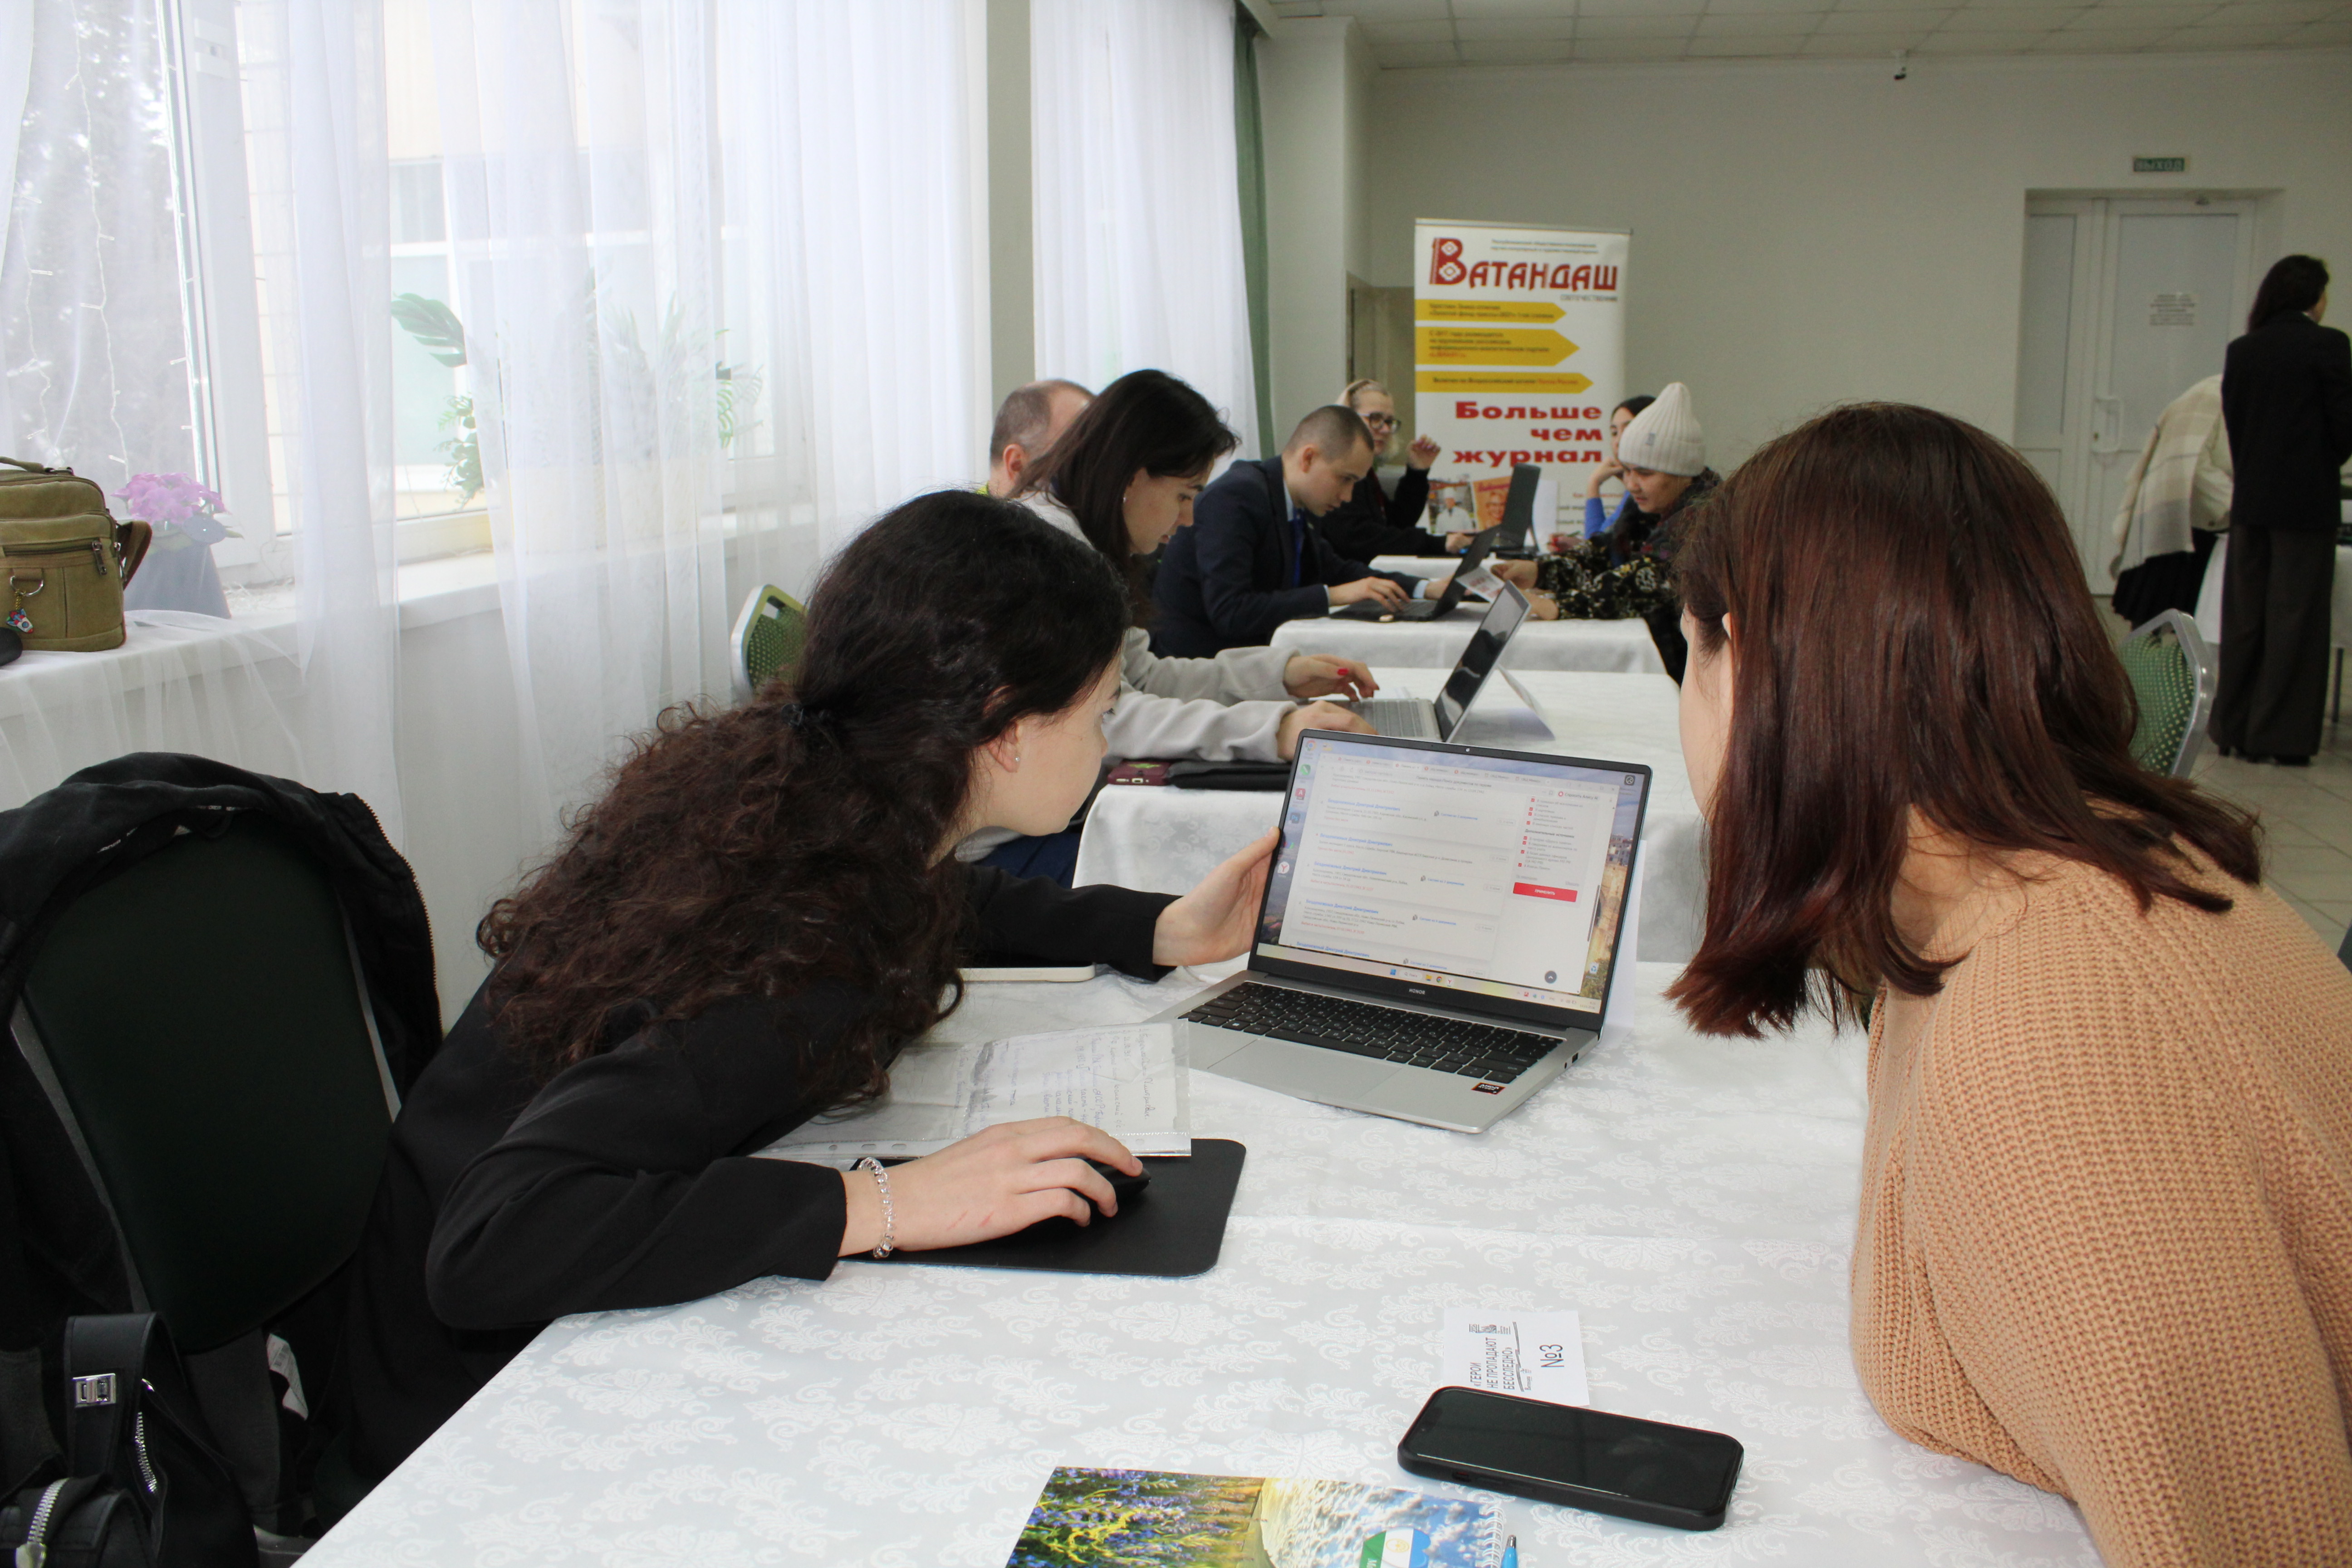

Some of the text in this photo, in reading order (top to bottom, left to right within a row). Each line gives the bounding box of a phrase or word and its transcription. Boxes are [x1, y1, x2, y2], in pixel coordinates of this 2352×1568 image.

[1455, 402, 1602, 419] Больше
[1531, 429, 1602, 441] чем
[1453, 450, 1602, 467] журнал
[1485, 1337, 1499, 1389] НЕ ПРОПАДАЮТ
[1539, 1344, 1565, 1368] №3
[1469, 1362, 1482, 1387] «ГЕРОИ
[1502, 1347, 1515, 1390] БЕССЛЕДНО»
